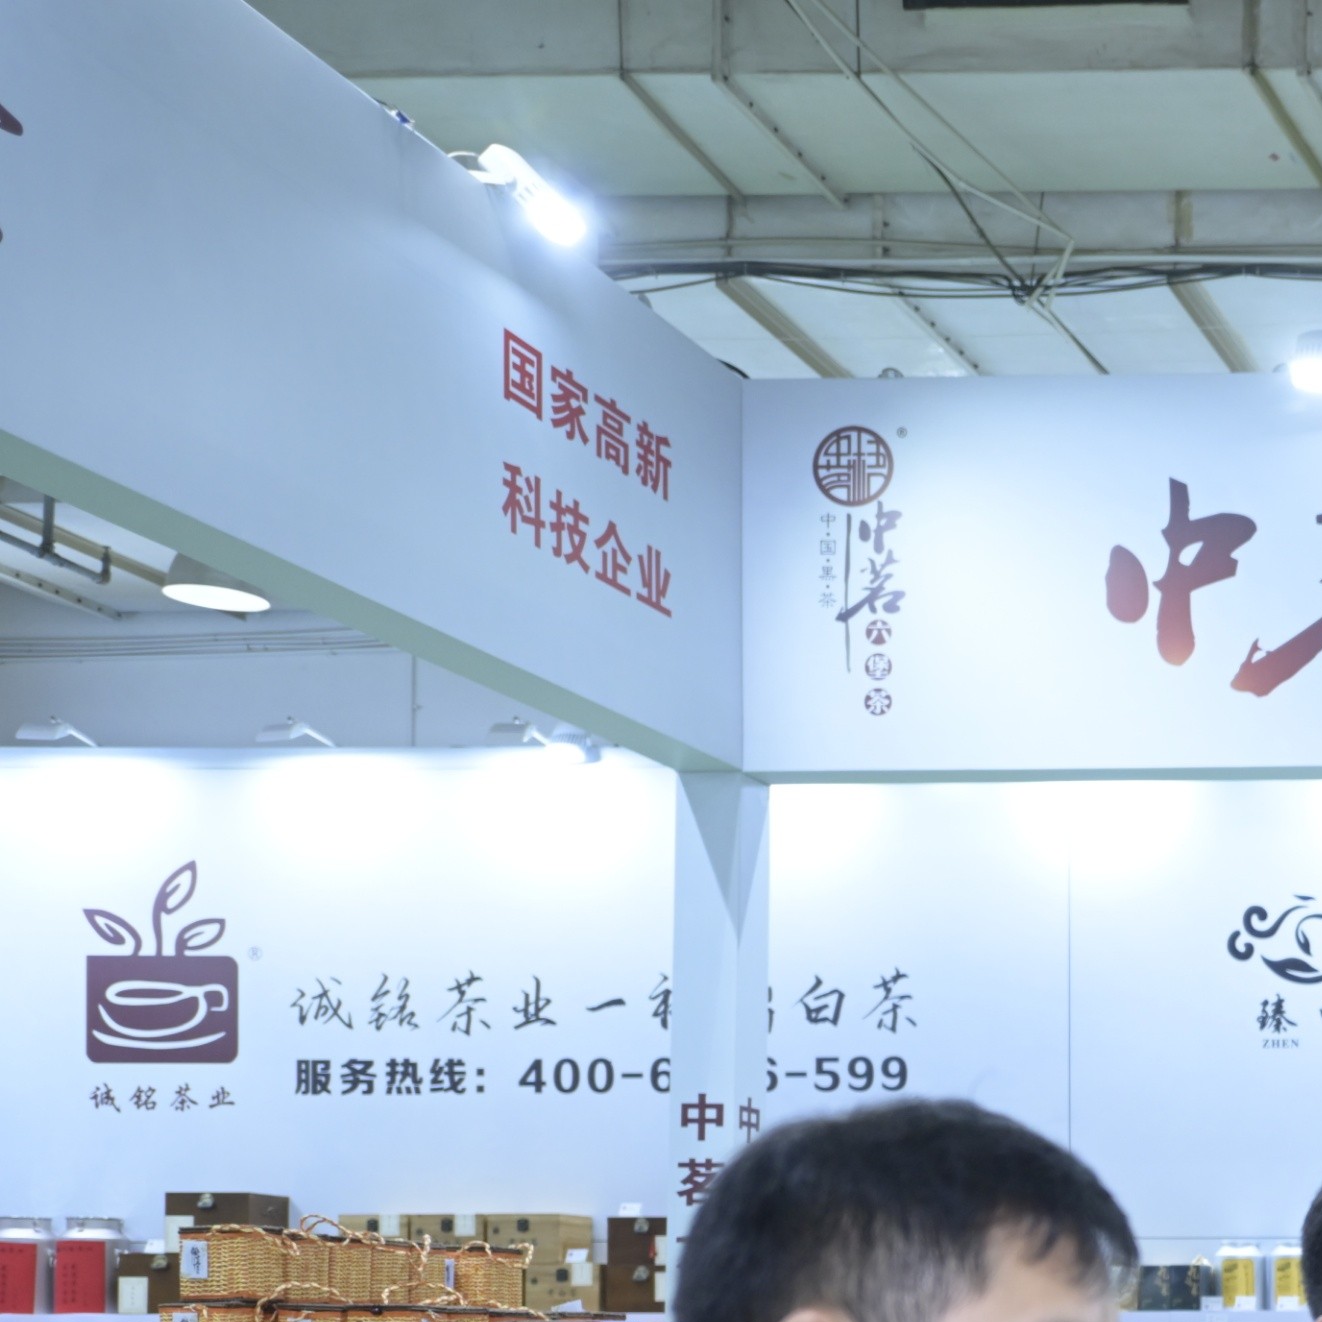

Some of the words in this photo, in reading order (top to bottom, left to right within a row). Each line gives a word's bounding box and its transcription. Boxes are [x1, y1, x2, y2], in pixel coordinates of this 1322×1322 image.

[503, 327, 673, 502] 国家高新
[502, 459, 674, 619] 科技企业
[290, 967, 919, 1035] 诚铭茶业一白茶
[1261, 1038, 1301, 1050] ZHEN
[89, 1081, 236, 1114] 诚铭茶业
